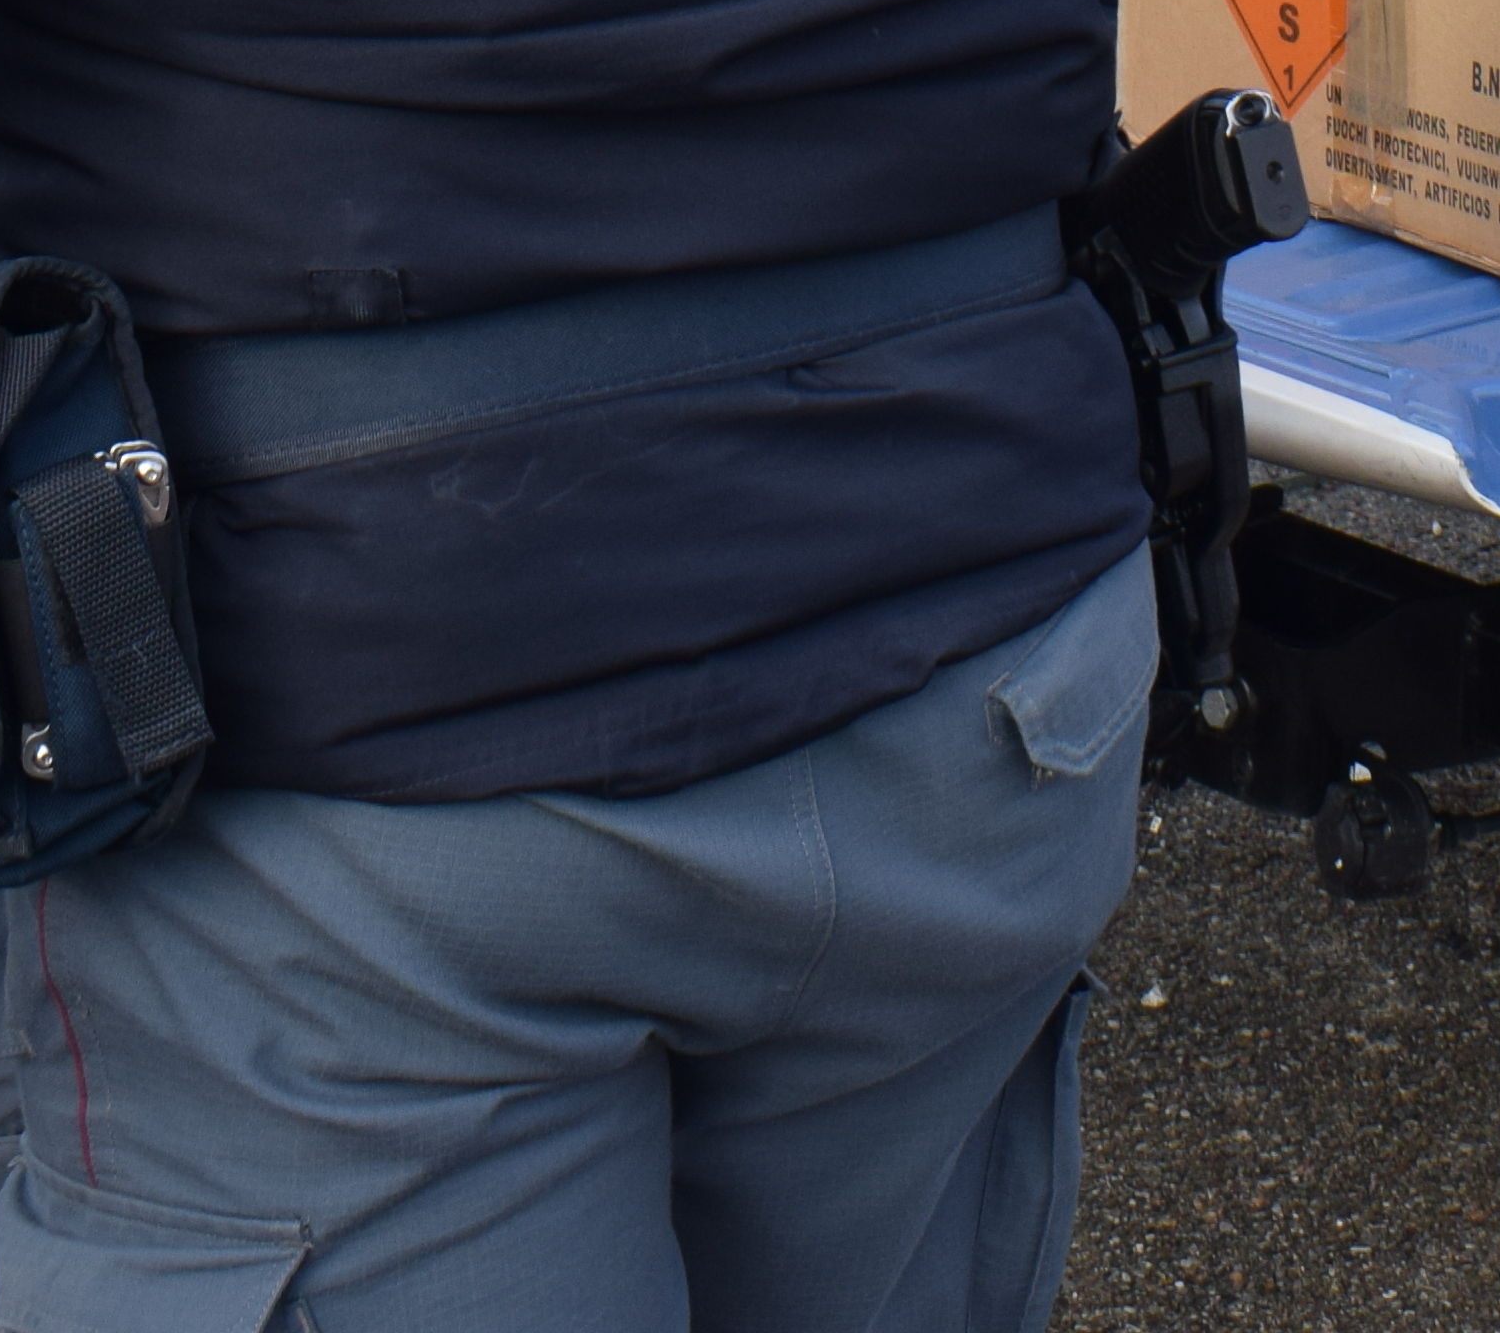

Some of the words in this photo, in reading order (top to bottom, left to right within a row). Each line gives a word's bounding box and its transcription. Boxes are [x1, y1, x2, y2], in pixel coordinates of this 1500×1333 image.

[1277, 2, 1299, 43] S
[1283, 64, 1293, 91] 1
[1326, 84, 1342, 106] UN
[1326, 116, 1368, 146] FUOCHI
[1373, 129, 1450, 176] PIROTECNICI,
[1425, 180, 1491, 220] ARTIFICIOS
